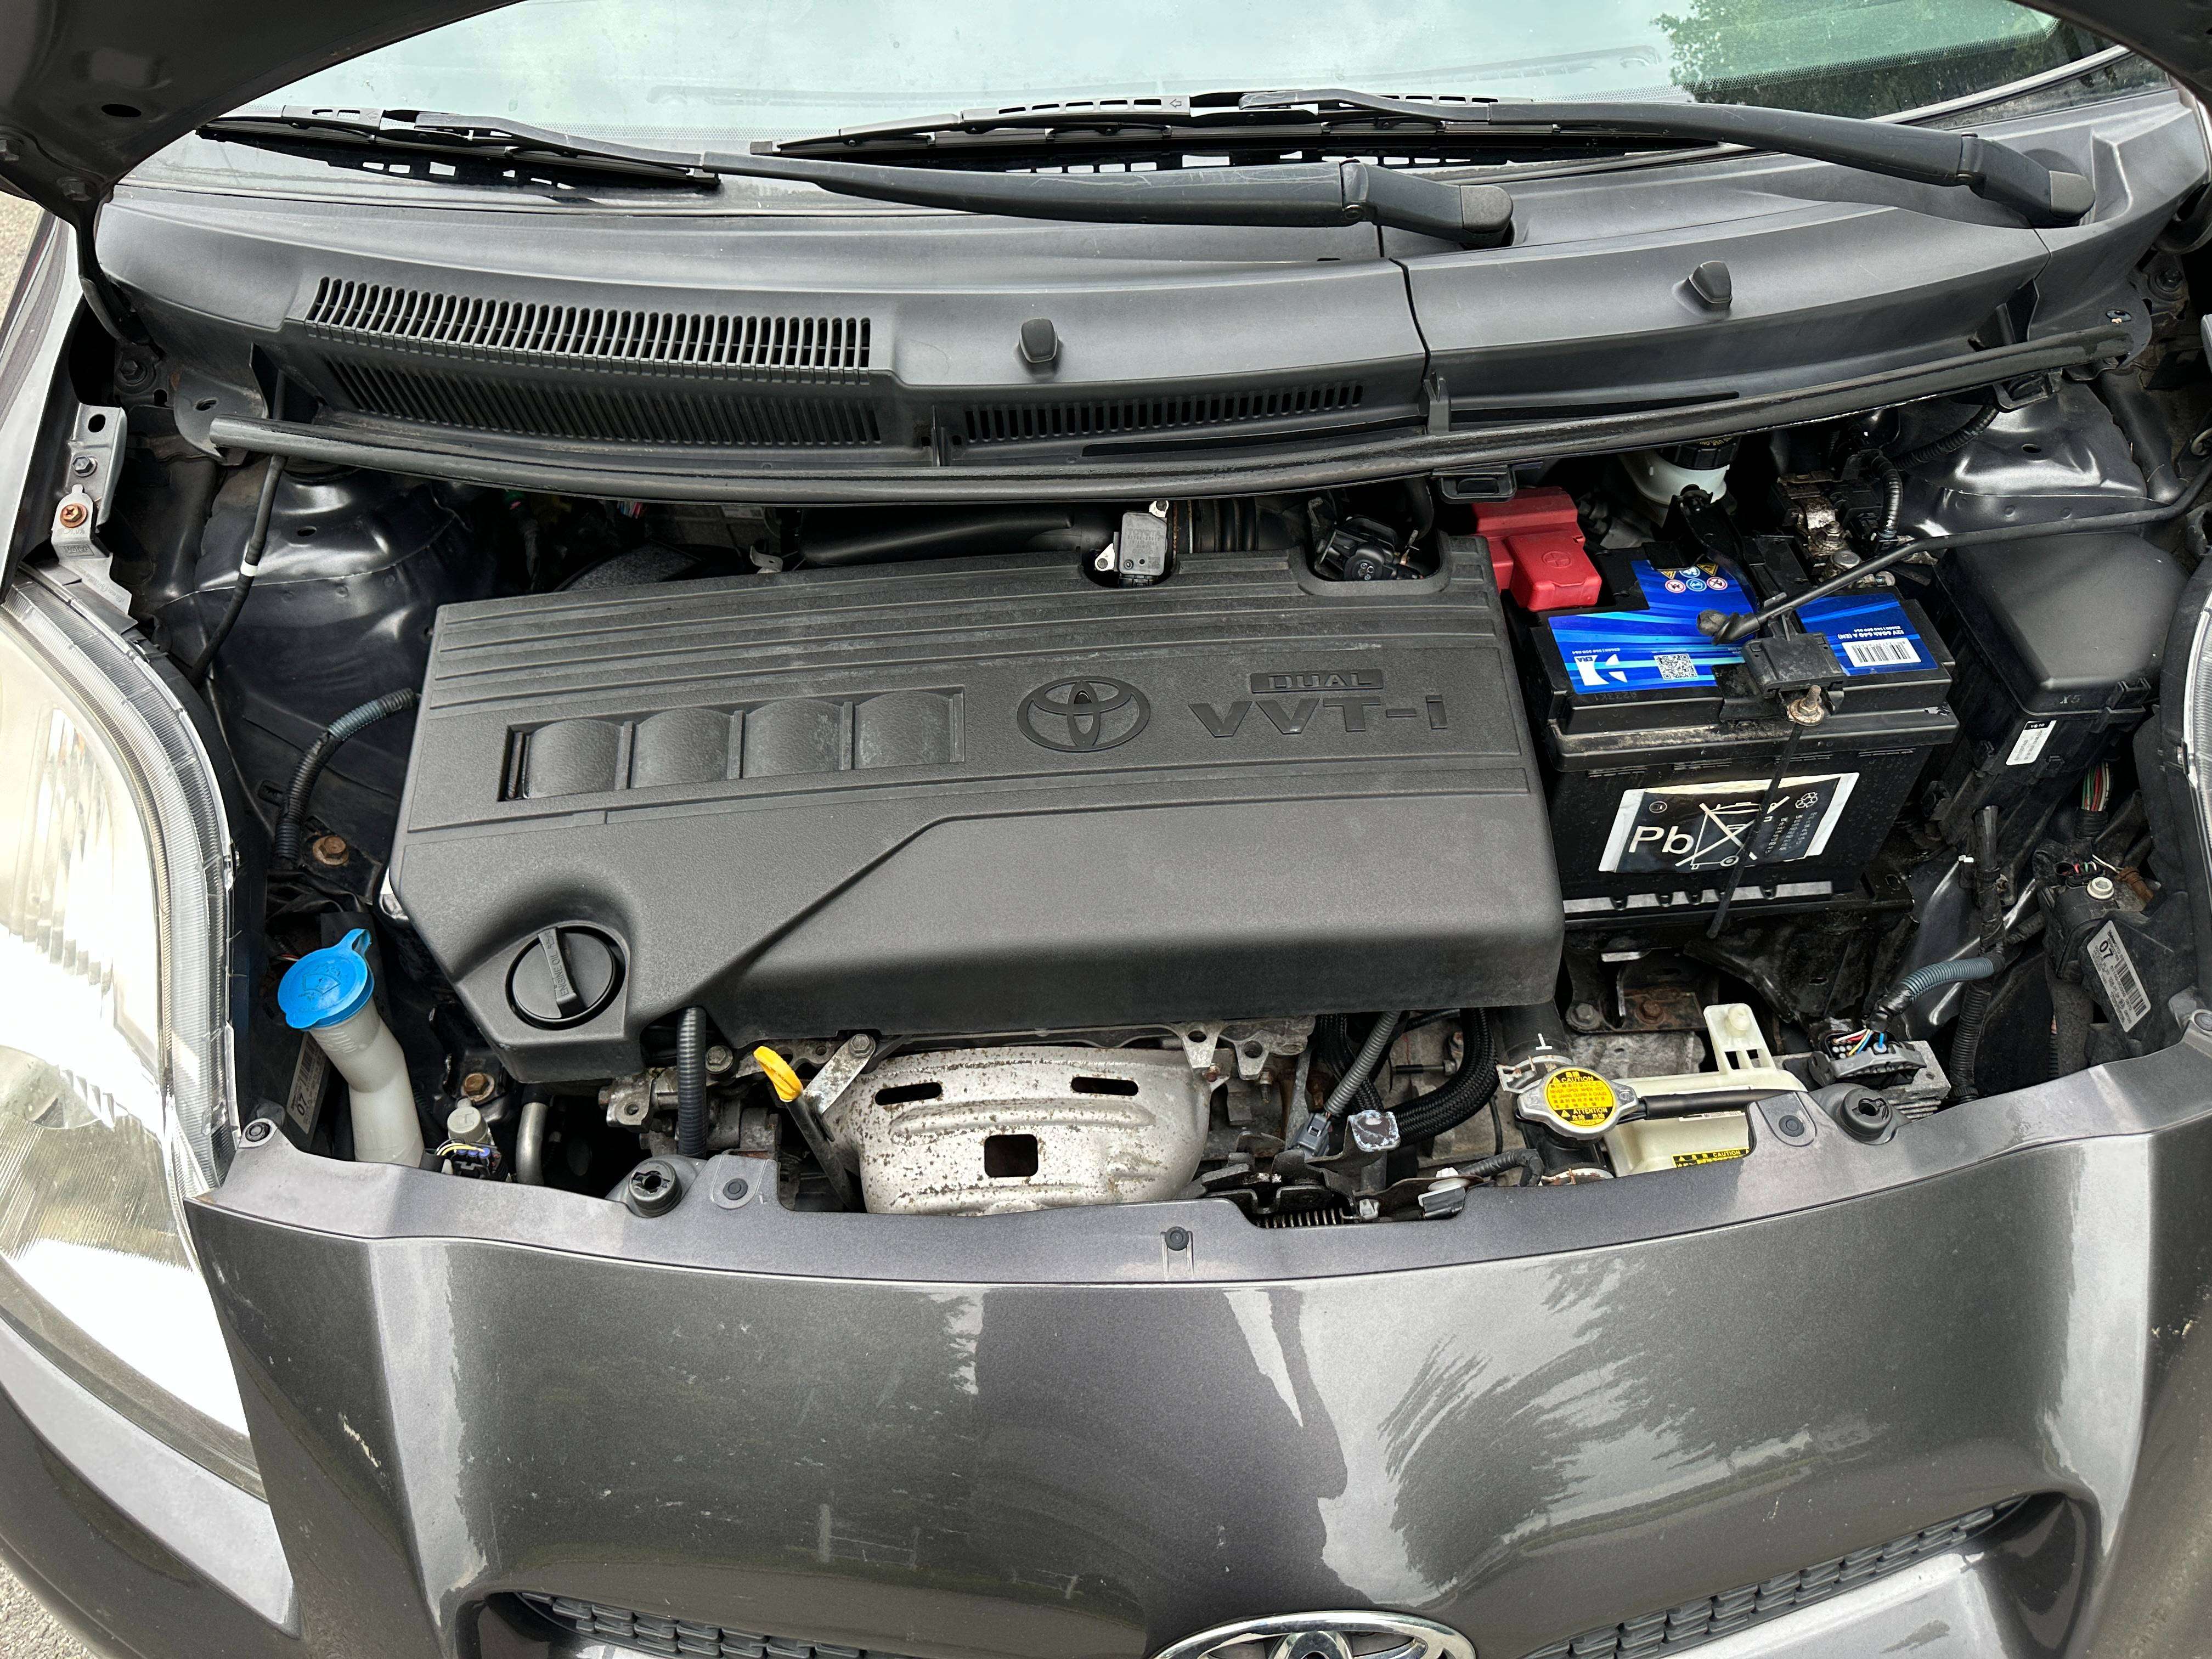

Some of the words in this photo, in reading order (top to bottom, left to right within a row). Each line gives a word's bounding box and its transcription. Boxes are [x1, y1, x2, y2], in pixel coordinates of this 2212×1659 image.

[1268, 672, 1372, 688] DUAL
[1628, 826, 1694, 854] Pb
[549, 950, 560, 965] OIL
[2100, 940, 2113, 959] 07
[553, 966, 569, 997] ENGINE
[297, 1092, 307, 1116] 07
